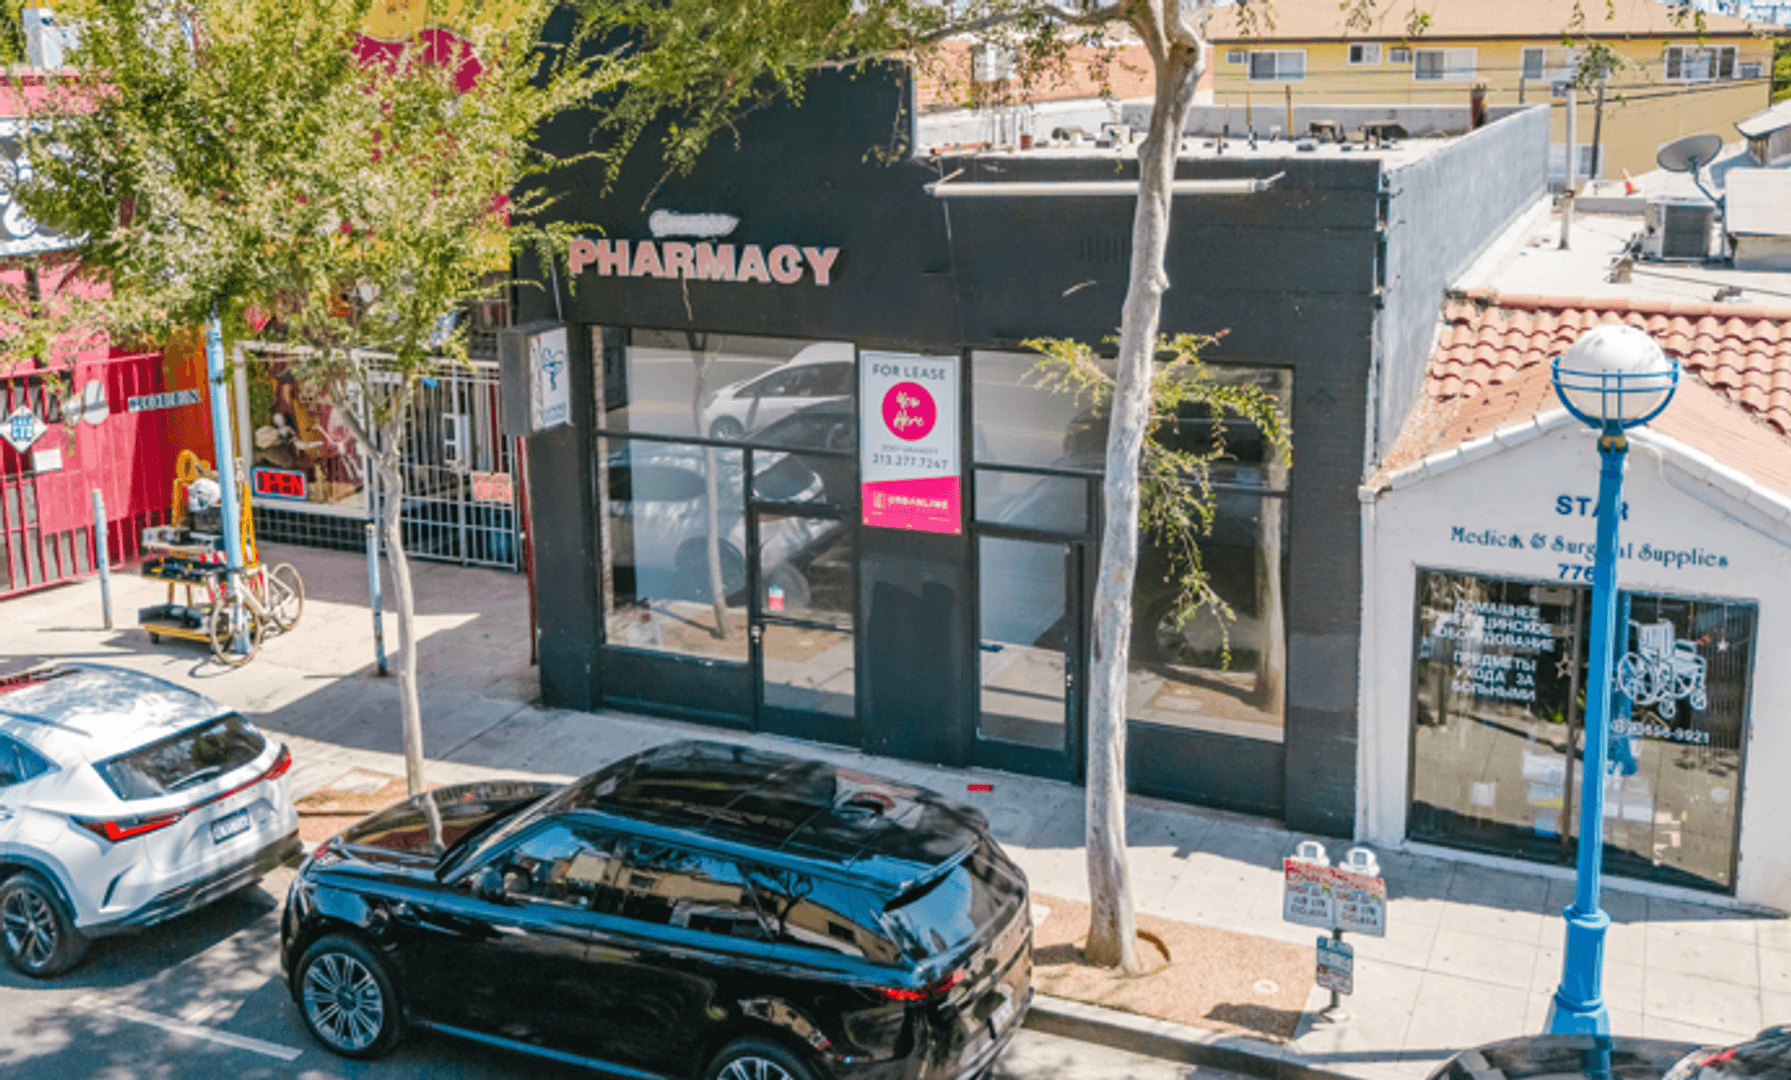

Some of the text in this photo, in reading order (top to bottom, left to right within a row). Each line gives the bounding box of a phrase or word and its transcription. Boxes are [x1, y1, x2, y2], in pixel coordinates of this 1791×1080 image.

[569, 239, 840, 286] PHARMACY
[872, 363, 946, 381] FOR LEASE
[255, 470, 305, 498] OPEN
[1555, 495, 1629, 520] STR
[1530, 532, 1548, 549] &
[1551, 535, 1633, 562] Surgal
[1638, 543, 1729, 569] Supplies
